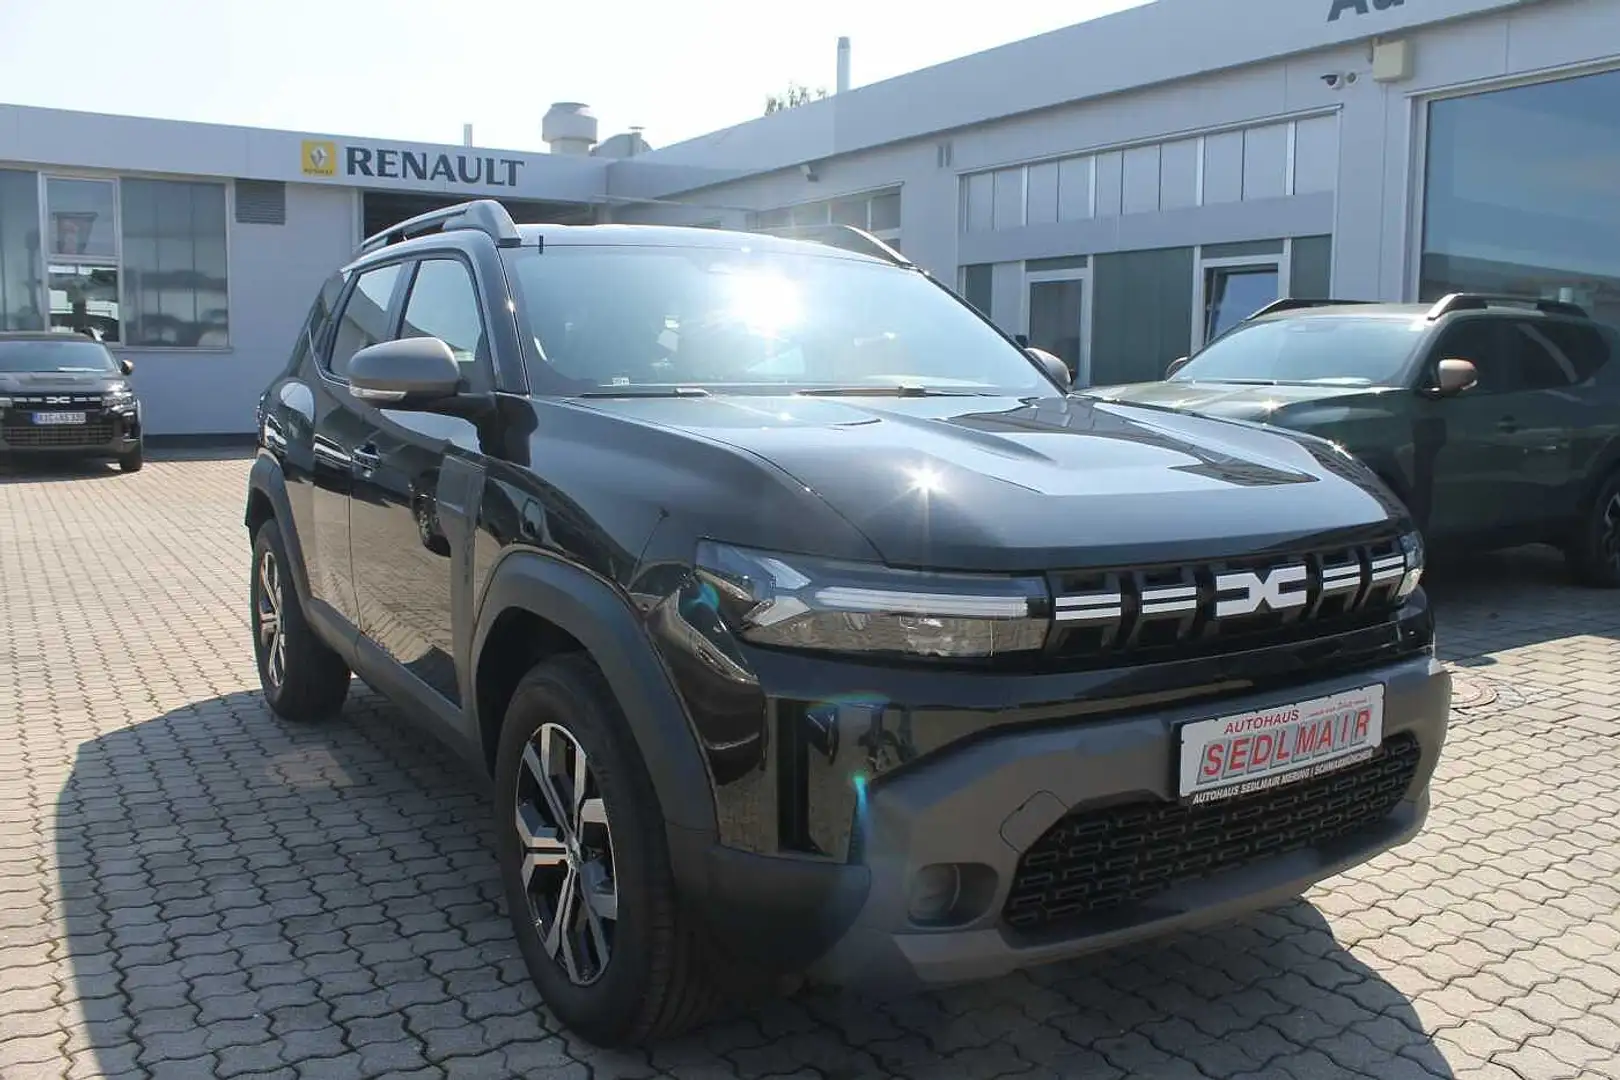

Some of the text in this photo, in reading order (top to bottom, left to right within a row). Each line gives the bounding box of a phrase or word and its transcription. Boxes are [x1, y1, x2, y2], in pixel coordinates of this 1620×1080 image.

[346, 146, 524, 187] RENAULT
[1224, 709, 1300, 734] AUTOHAUS
[1203, 709, 1371, 776] SEDLMAIR
[1192, 785, 1240, 805] AUTOHAUS
[1240, 774, 1281, 794] SEDLMAIR
